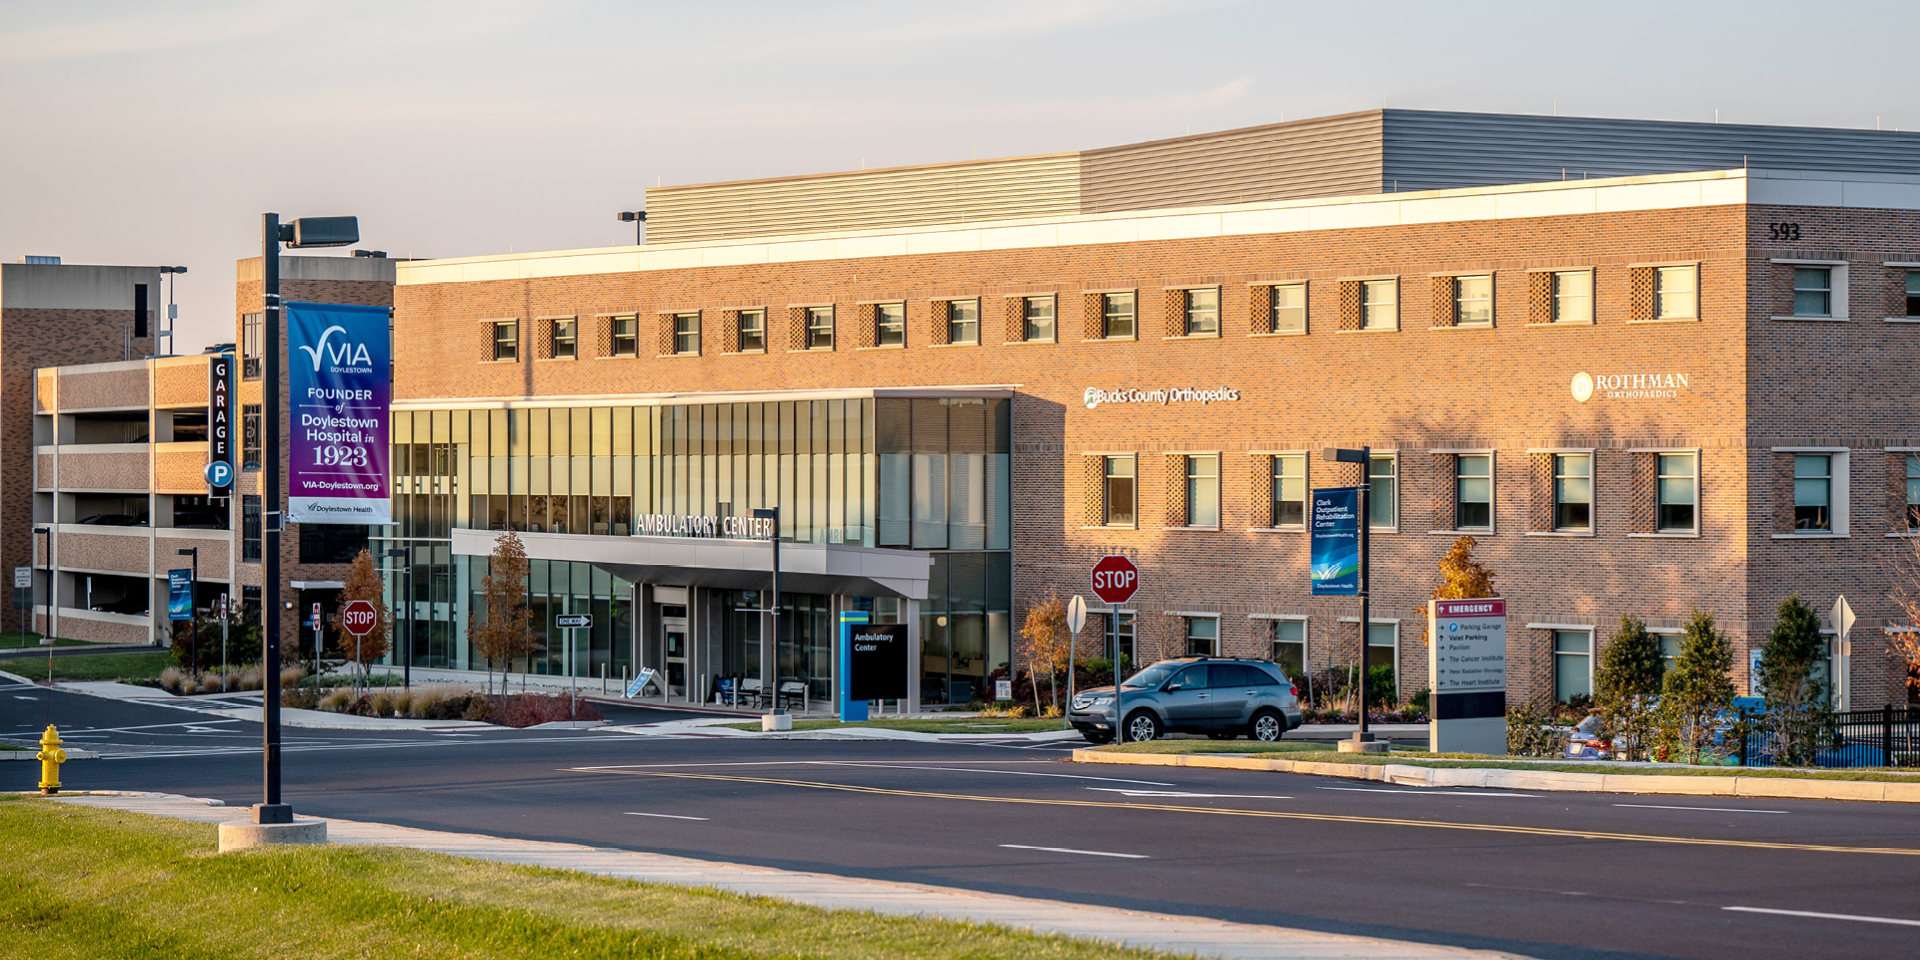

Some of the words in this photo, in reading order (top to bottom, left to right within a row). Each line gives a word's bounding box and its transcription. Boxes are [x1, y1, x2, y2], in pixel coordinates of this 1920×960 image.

[1769, 222, 1799, 240] 593
[327, 343, 372, 366] VIA
[330, 366, 373, 374] DOYLESTOWN
[1596, 373, 1690, 390] ROTHMAN
[308, 388, 372, 400] FOUNDER
[1097, 389, 1128, 403] Bucks
[1129, 389, 1169, 406] County
[1170, 386, 1240, 405] Orthopedics
[1607, 390, 1677, 398] ORTHOPAEDICS
[215, 363, 227, 454] GARAGE
[334, 402, 345, 413] of
[301, 413, 379, 430] Doylestown
[306, 429, 362, 444] Hospital
[365, 434, 375, 443] in
[312, 445, 368, 467] 1923
[214, 465, 228, 482] P
[302, 481, 379, 491] VIA-Doylestown.org
[316, 505, 353, 513] Doylestown
[353, 505, 373, 513] Health
[1316, 506, 1348, 514] Outpatient
[637, 513, 719, 535] AMBULATORY
[723, 516, 773, 537] CENTER
[1094, 570, 1136, 589] STOP
[1449, 604, 1493, 613] EMERGENCY
[346, 611, 374, 624] STOP
[854, 633, 894, 643] Ambulatory
[855, 643, 877, 651] Center
